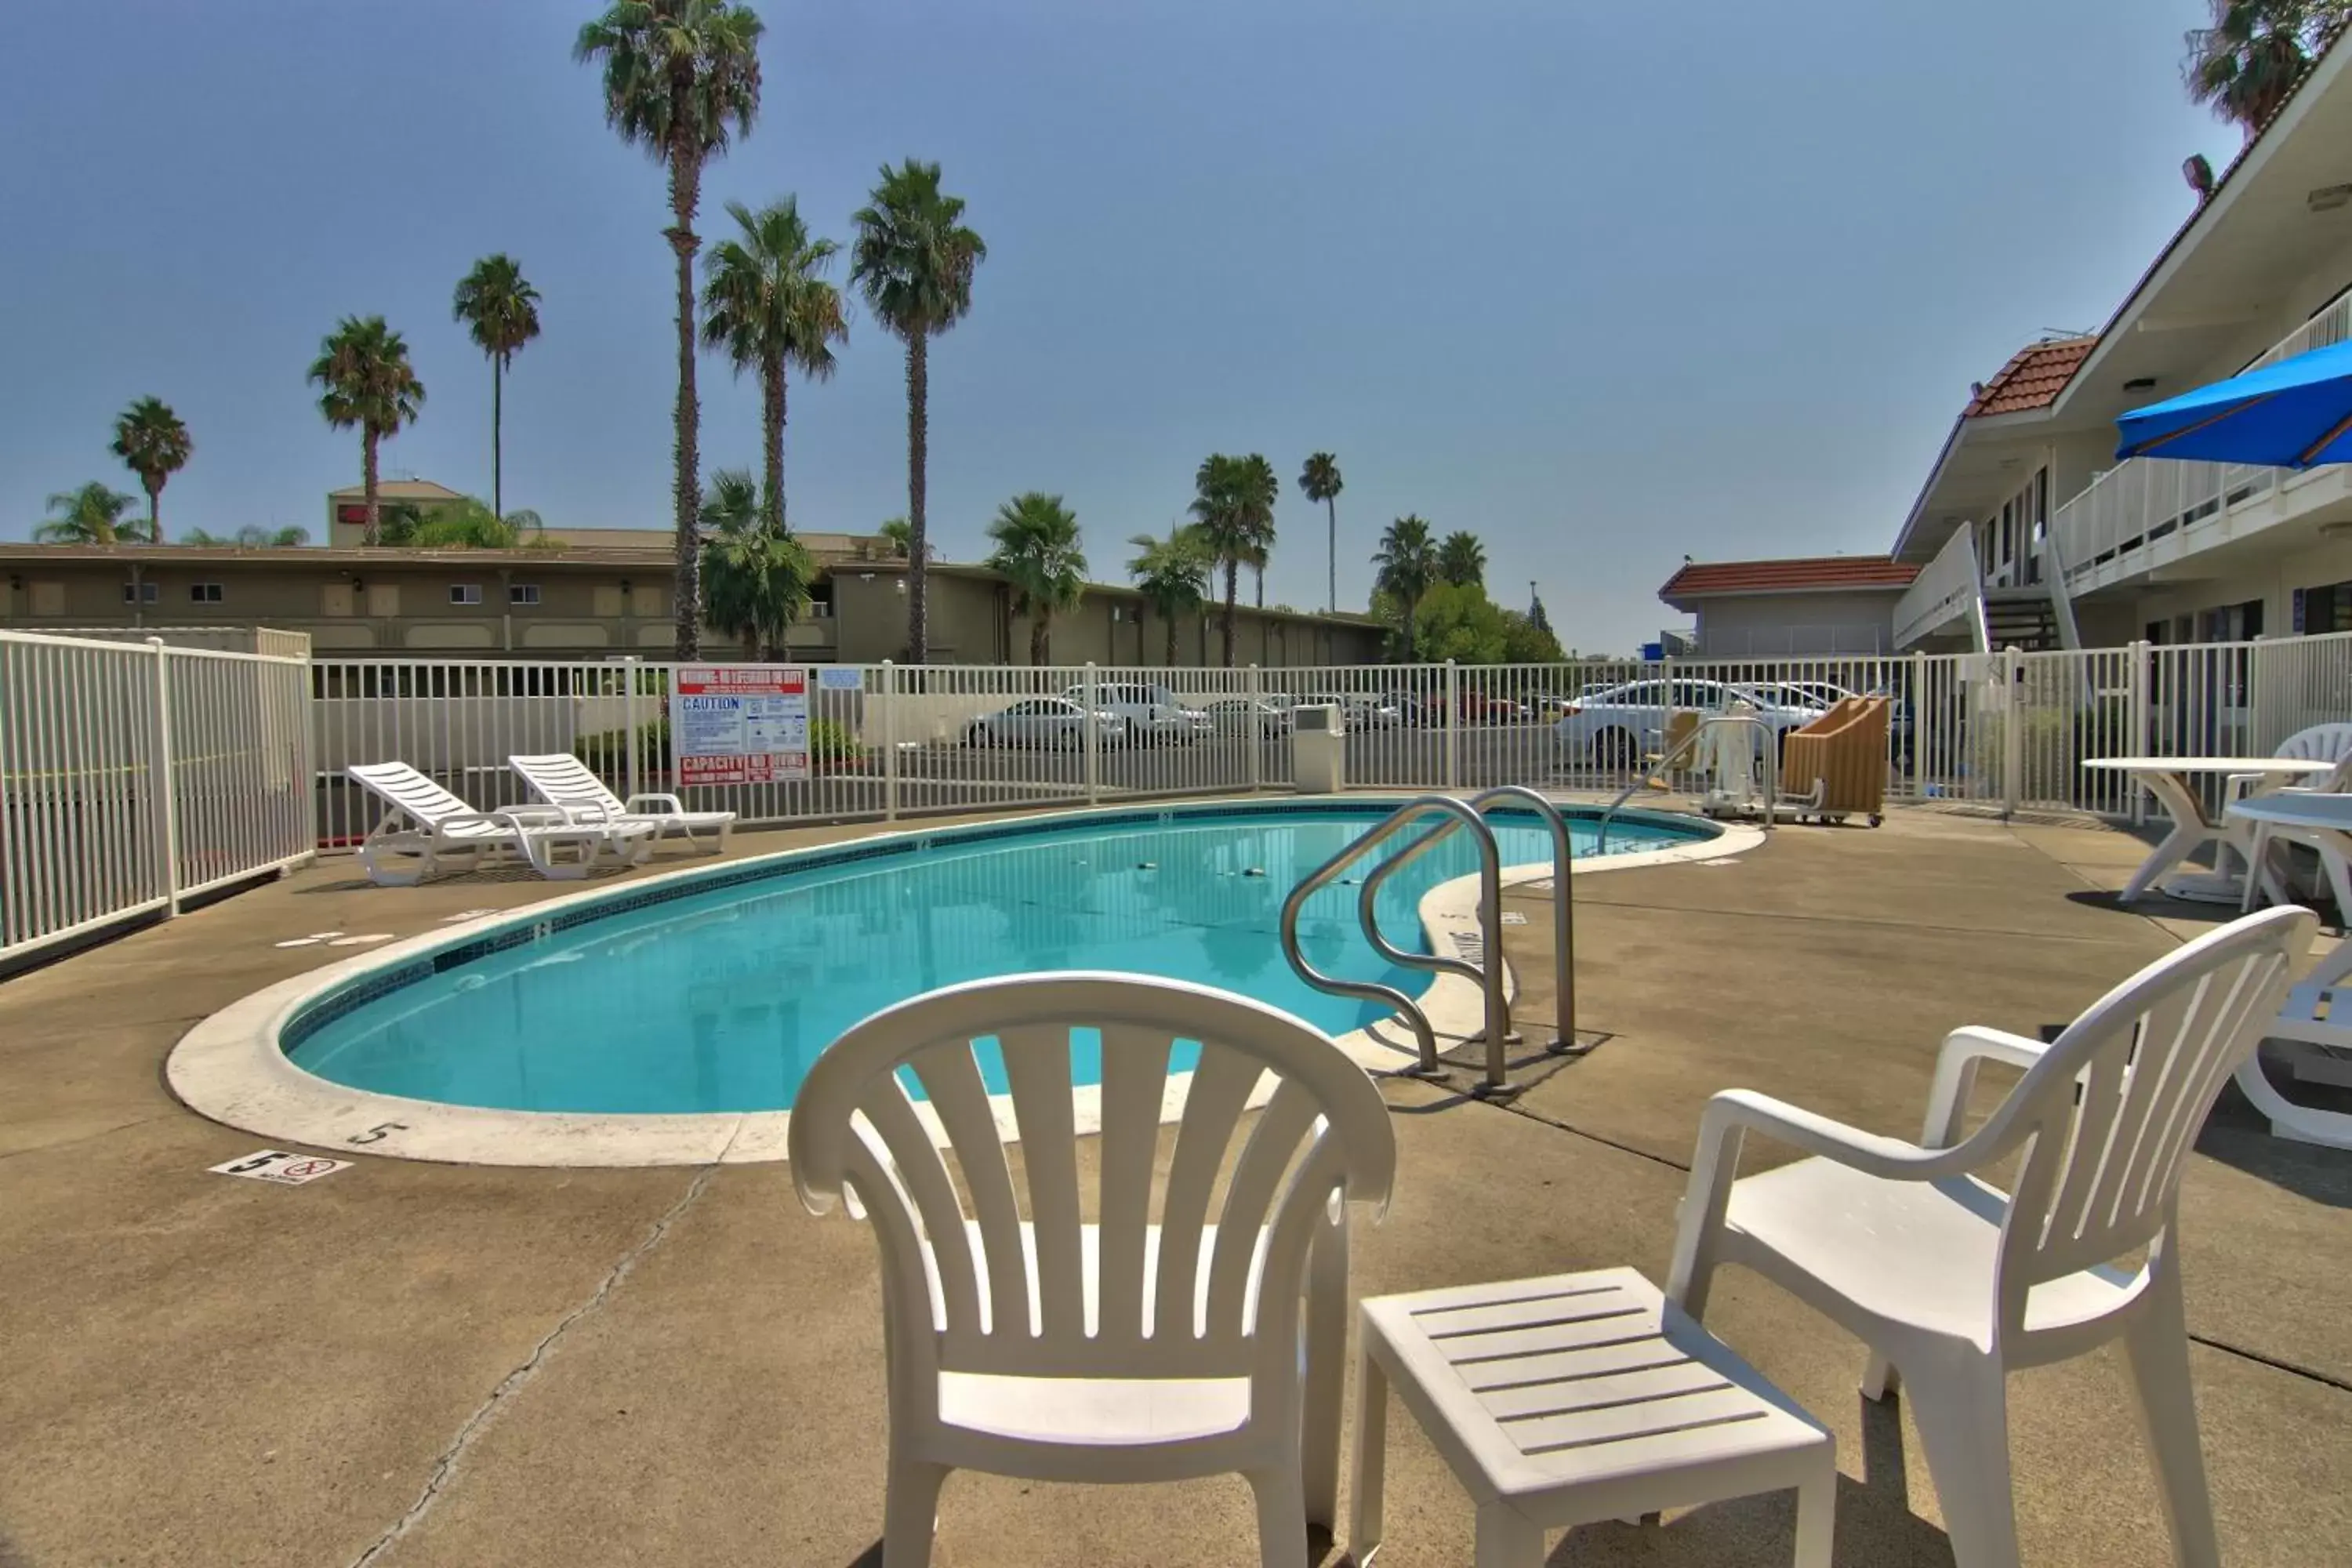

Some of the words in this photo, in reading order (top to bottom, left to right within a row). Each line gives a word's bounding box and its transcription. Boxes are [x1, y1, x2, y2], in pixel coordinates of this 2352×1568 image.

[683, 696, 740, 710] CAUTION
[683, 756, 744, 772] CAPACITY
[347, 1122, 409, 1145] 5
[227, 1152, 289, 1174] 5
